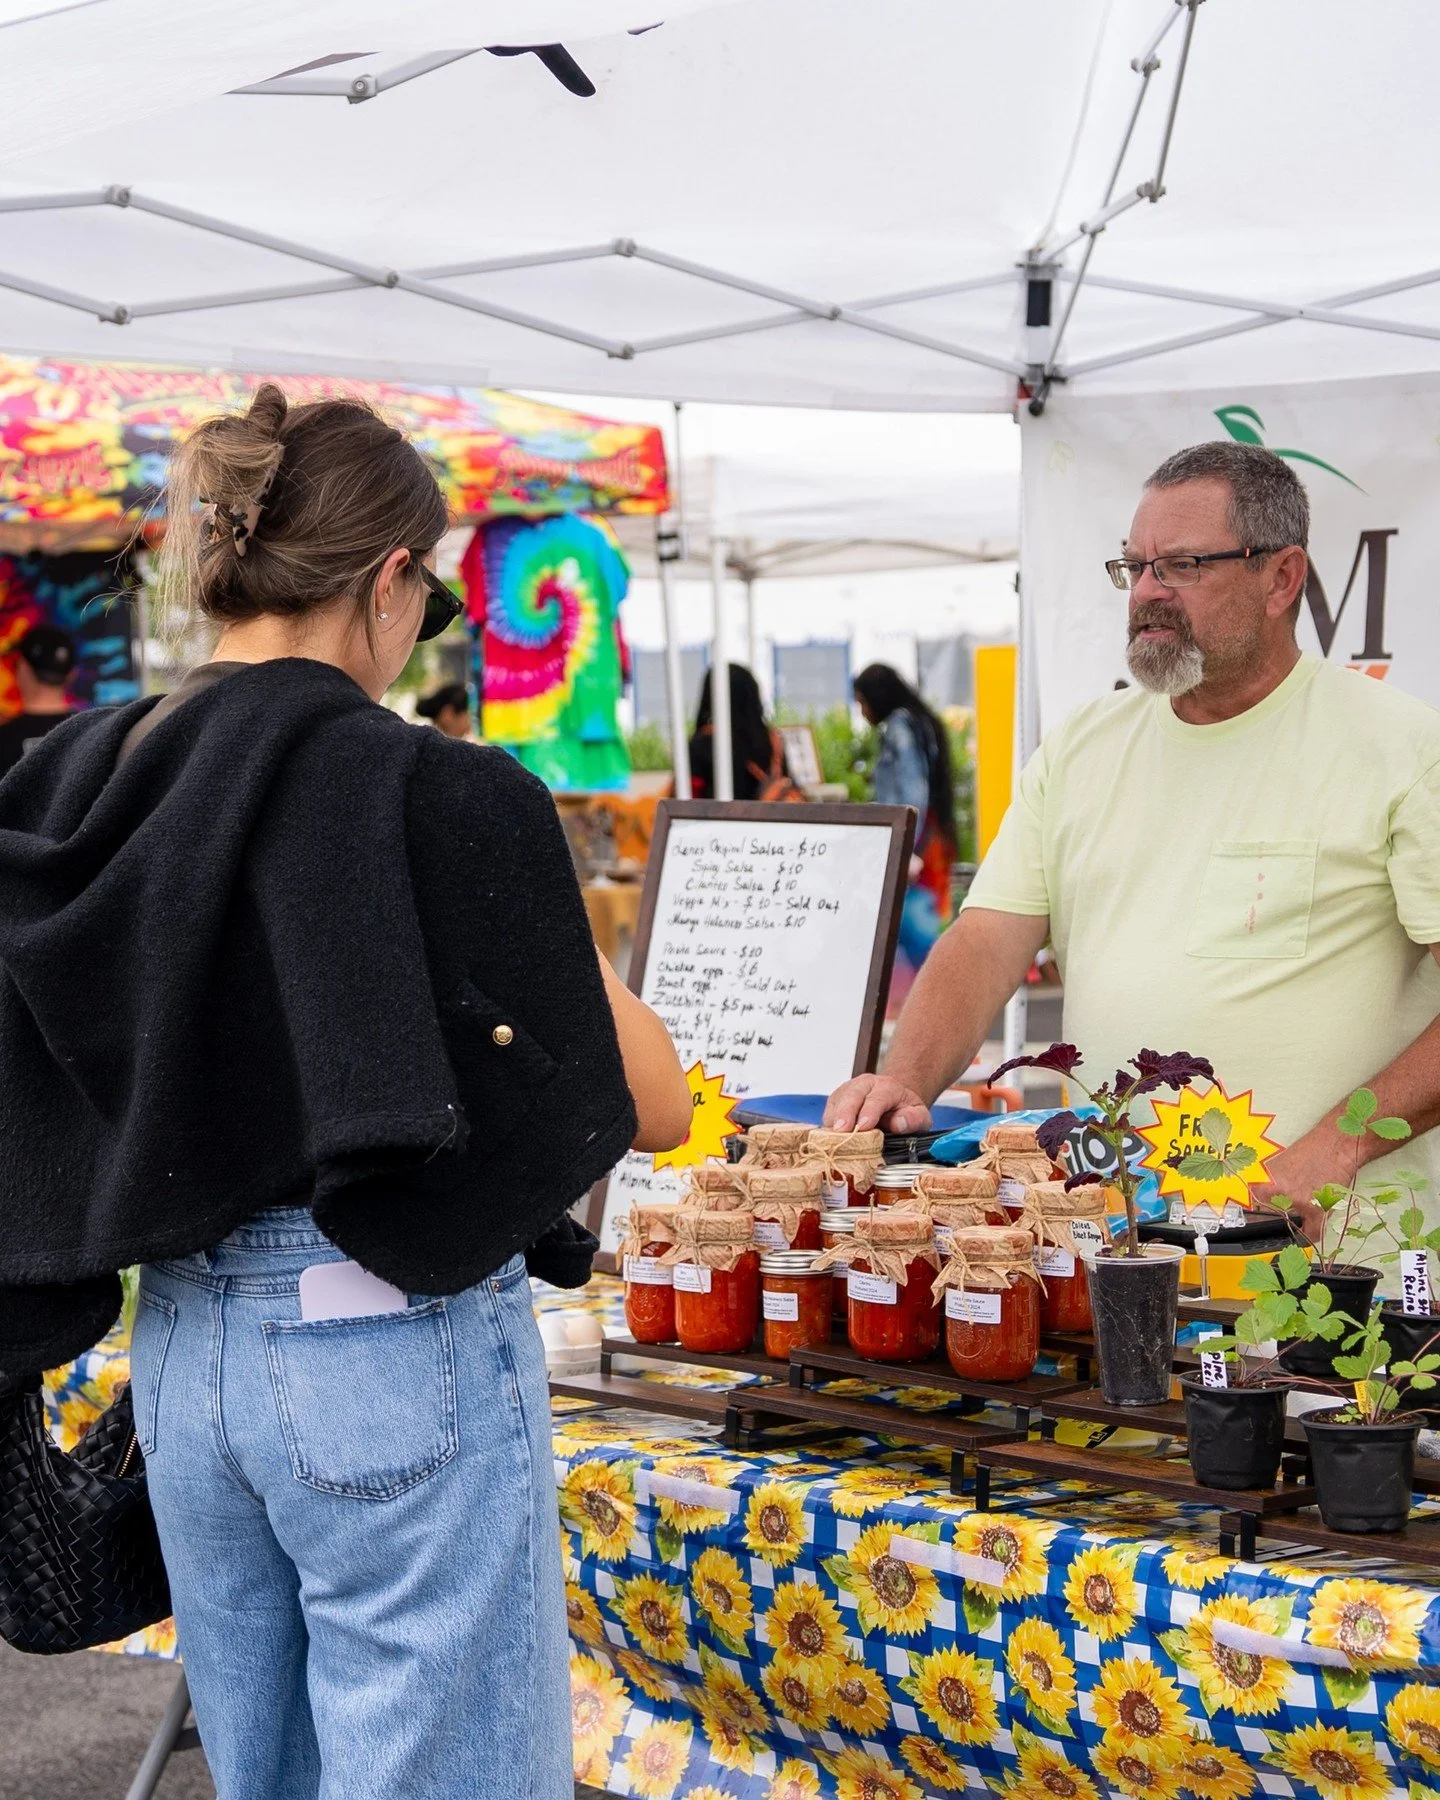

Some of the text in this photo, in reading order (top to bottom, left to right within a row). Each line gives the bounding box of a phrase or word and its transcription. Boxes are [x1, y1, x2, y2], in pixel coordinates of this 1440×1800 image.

[750, 838, 784, 856] Salsa
[692, 859, 719, 879] Spicy
[725, 859, 754, 873] Salsa
[734, 877, 764, 891] Salsa
[786, 896, 810, 910] Sold
[745, 916, 775, 929] Salsa
[744, 976, 771, 993] Sold
[1413, 1254, 1428, 1293] Alpine
[1403, 1275, 1417, 1313] Reine
